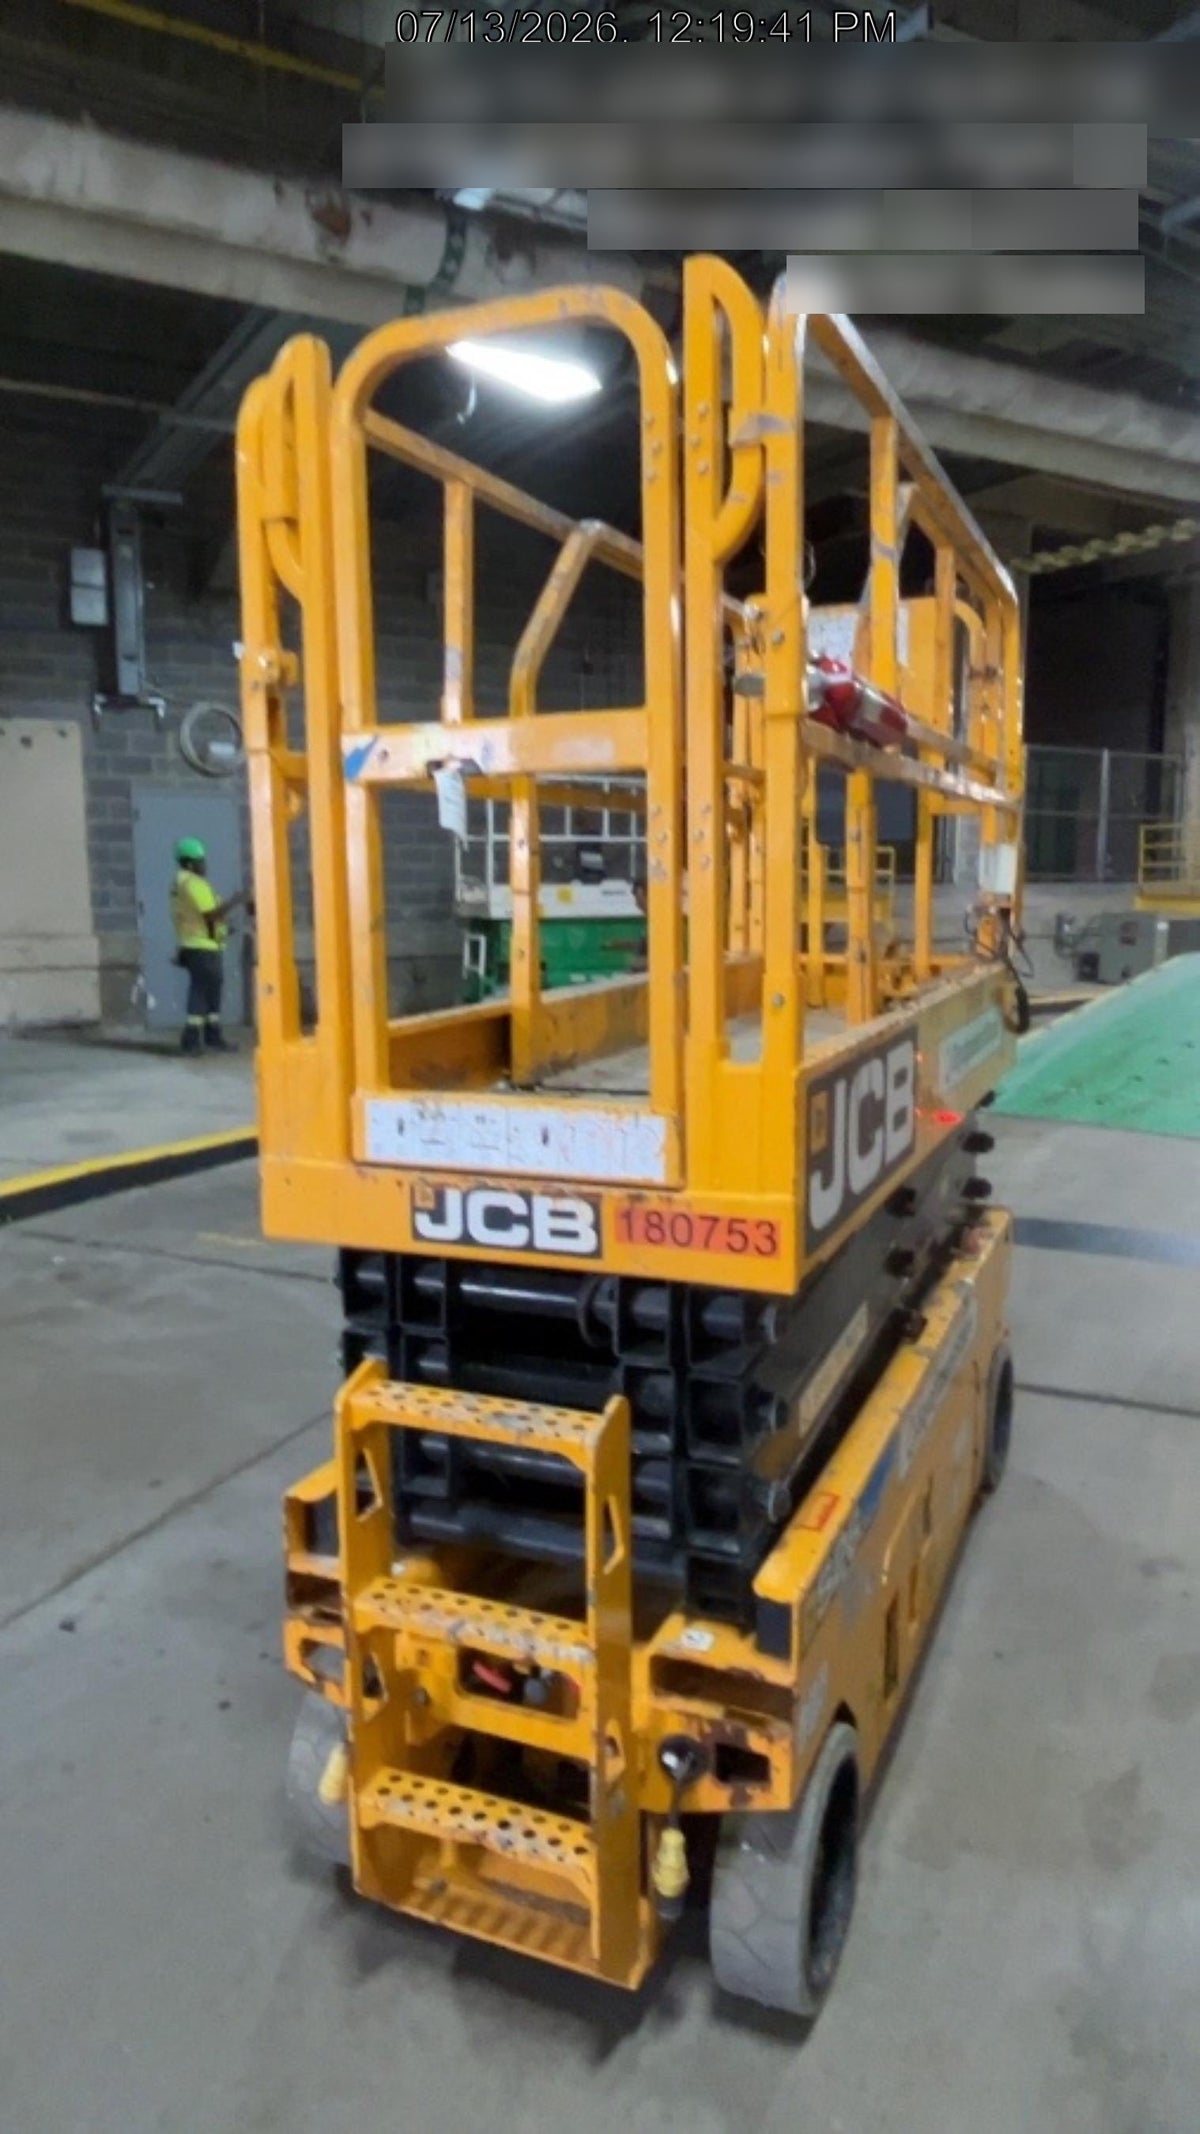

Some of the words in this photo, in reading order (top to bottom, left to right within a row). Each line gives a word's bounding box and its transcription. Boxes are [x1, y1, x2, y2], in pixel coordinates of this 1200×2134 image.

[809, 1040, 915, 1230] JCB
[414, 1187, 598, 1254] JCB
[620, 1208, 778, 1256] 180753
